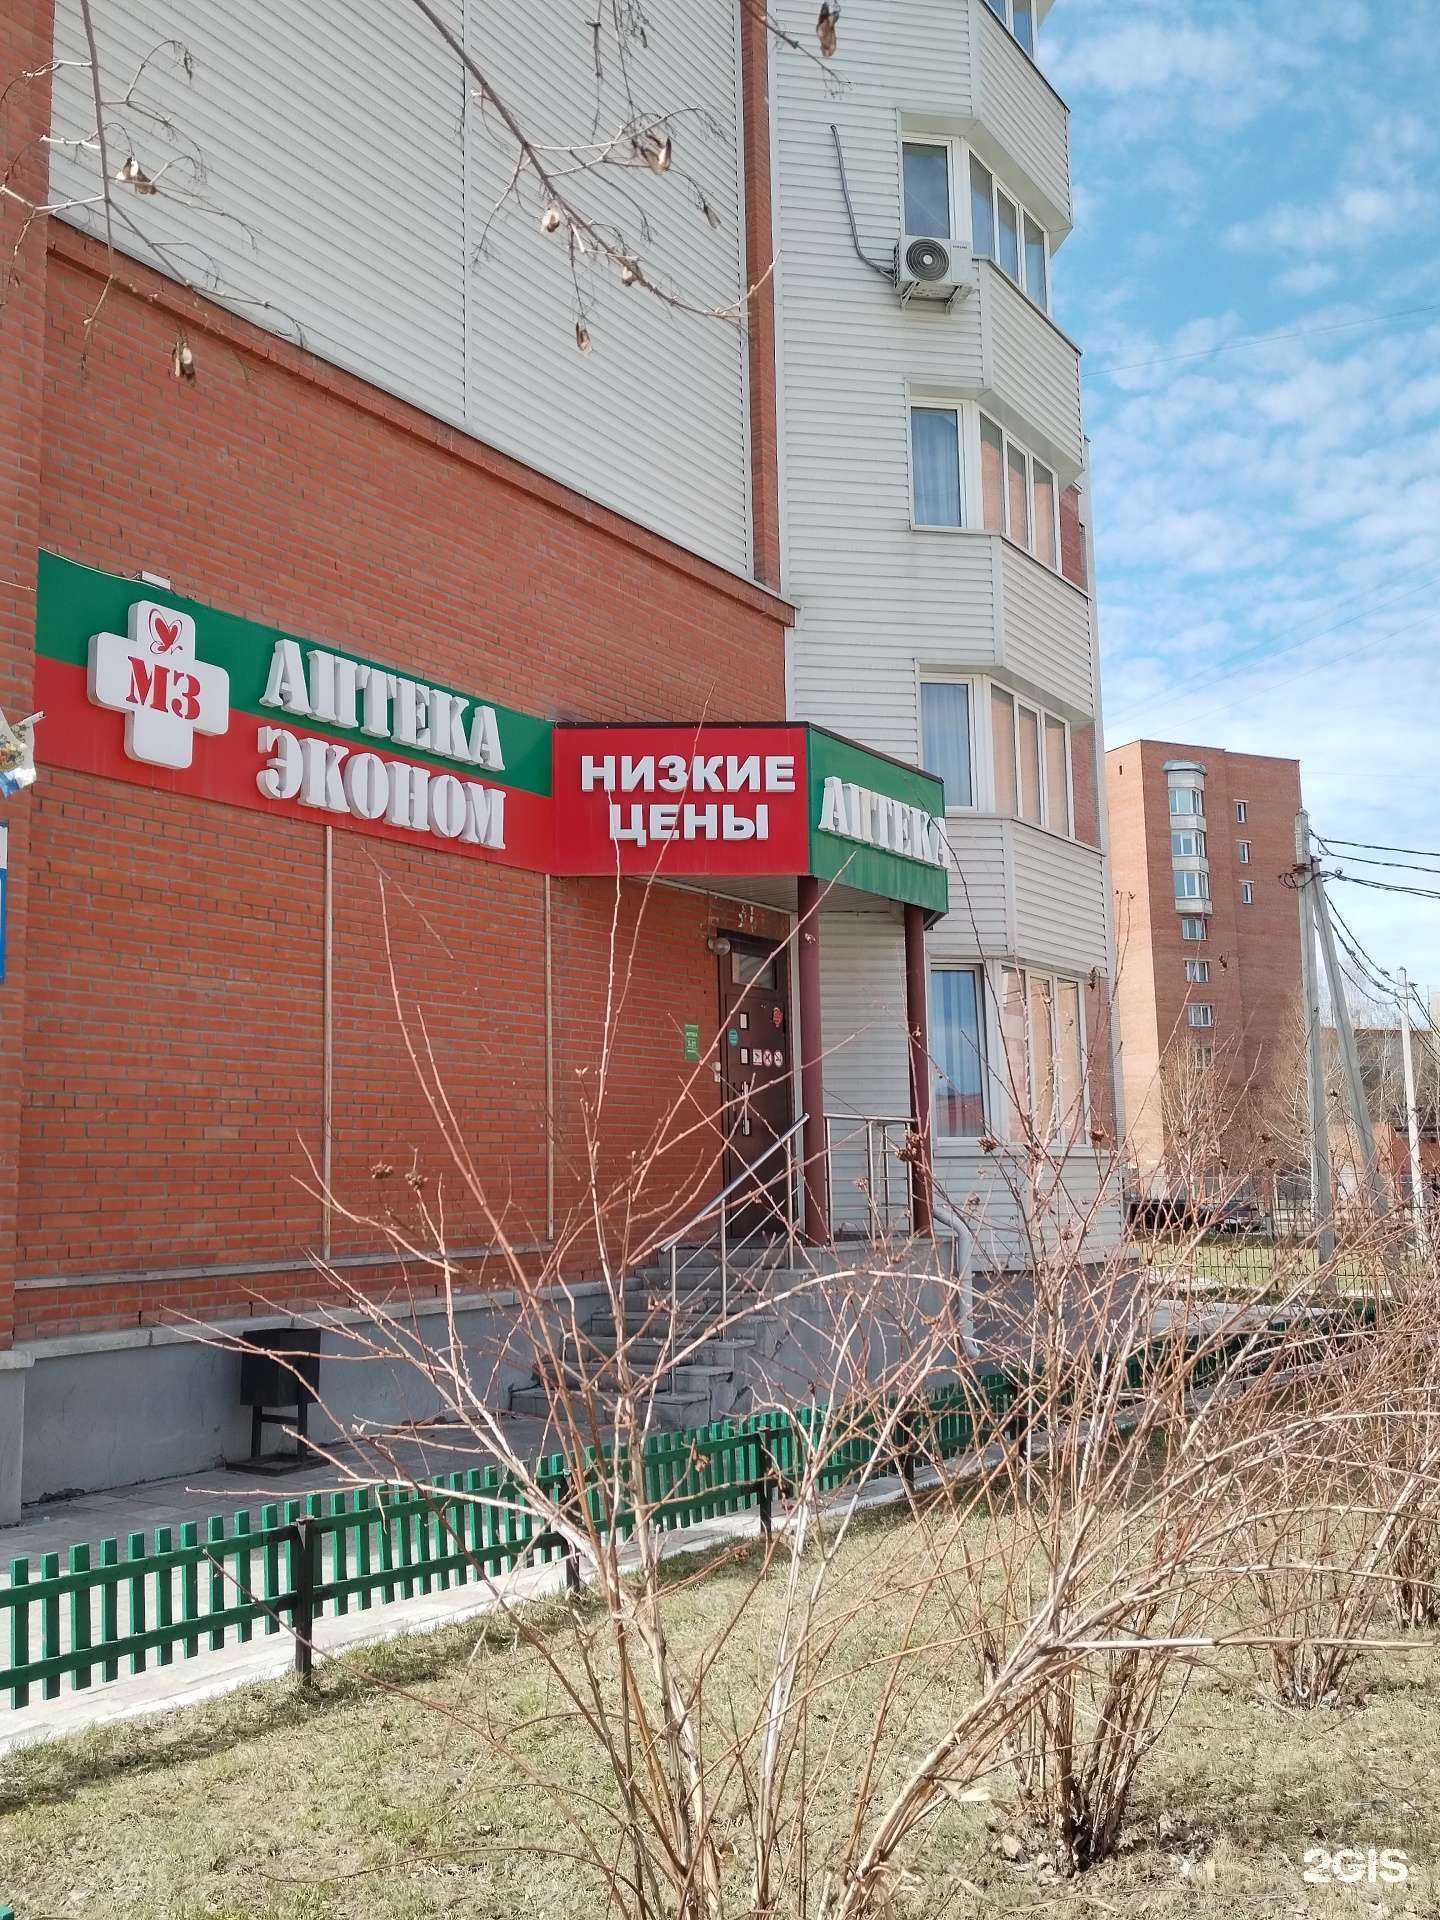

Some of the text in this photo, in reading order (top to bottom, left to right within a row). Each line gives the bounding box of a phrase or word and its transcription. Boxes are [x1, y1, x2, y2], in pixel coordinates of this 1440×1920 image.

[258, 639, 505, 772] АПТЕКА
[255, 725, 507, 850] ЭКОНОМ
[580, 755, 796, 793] НИЗКИЕ
[609, 803, 769, 848] ЦЕНЫ
[818, 776, 951, 871] АПТЕКА
